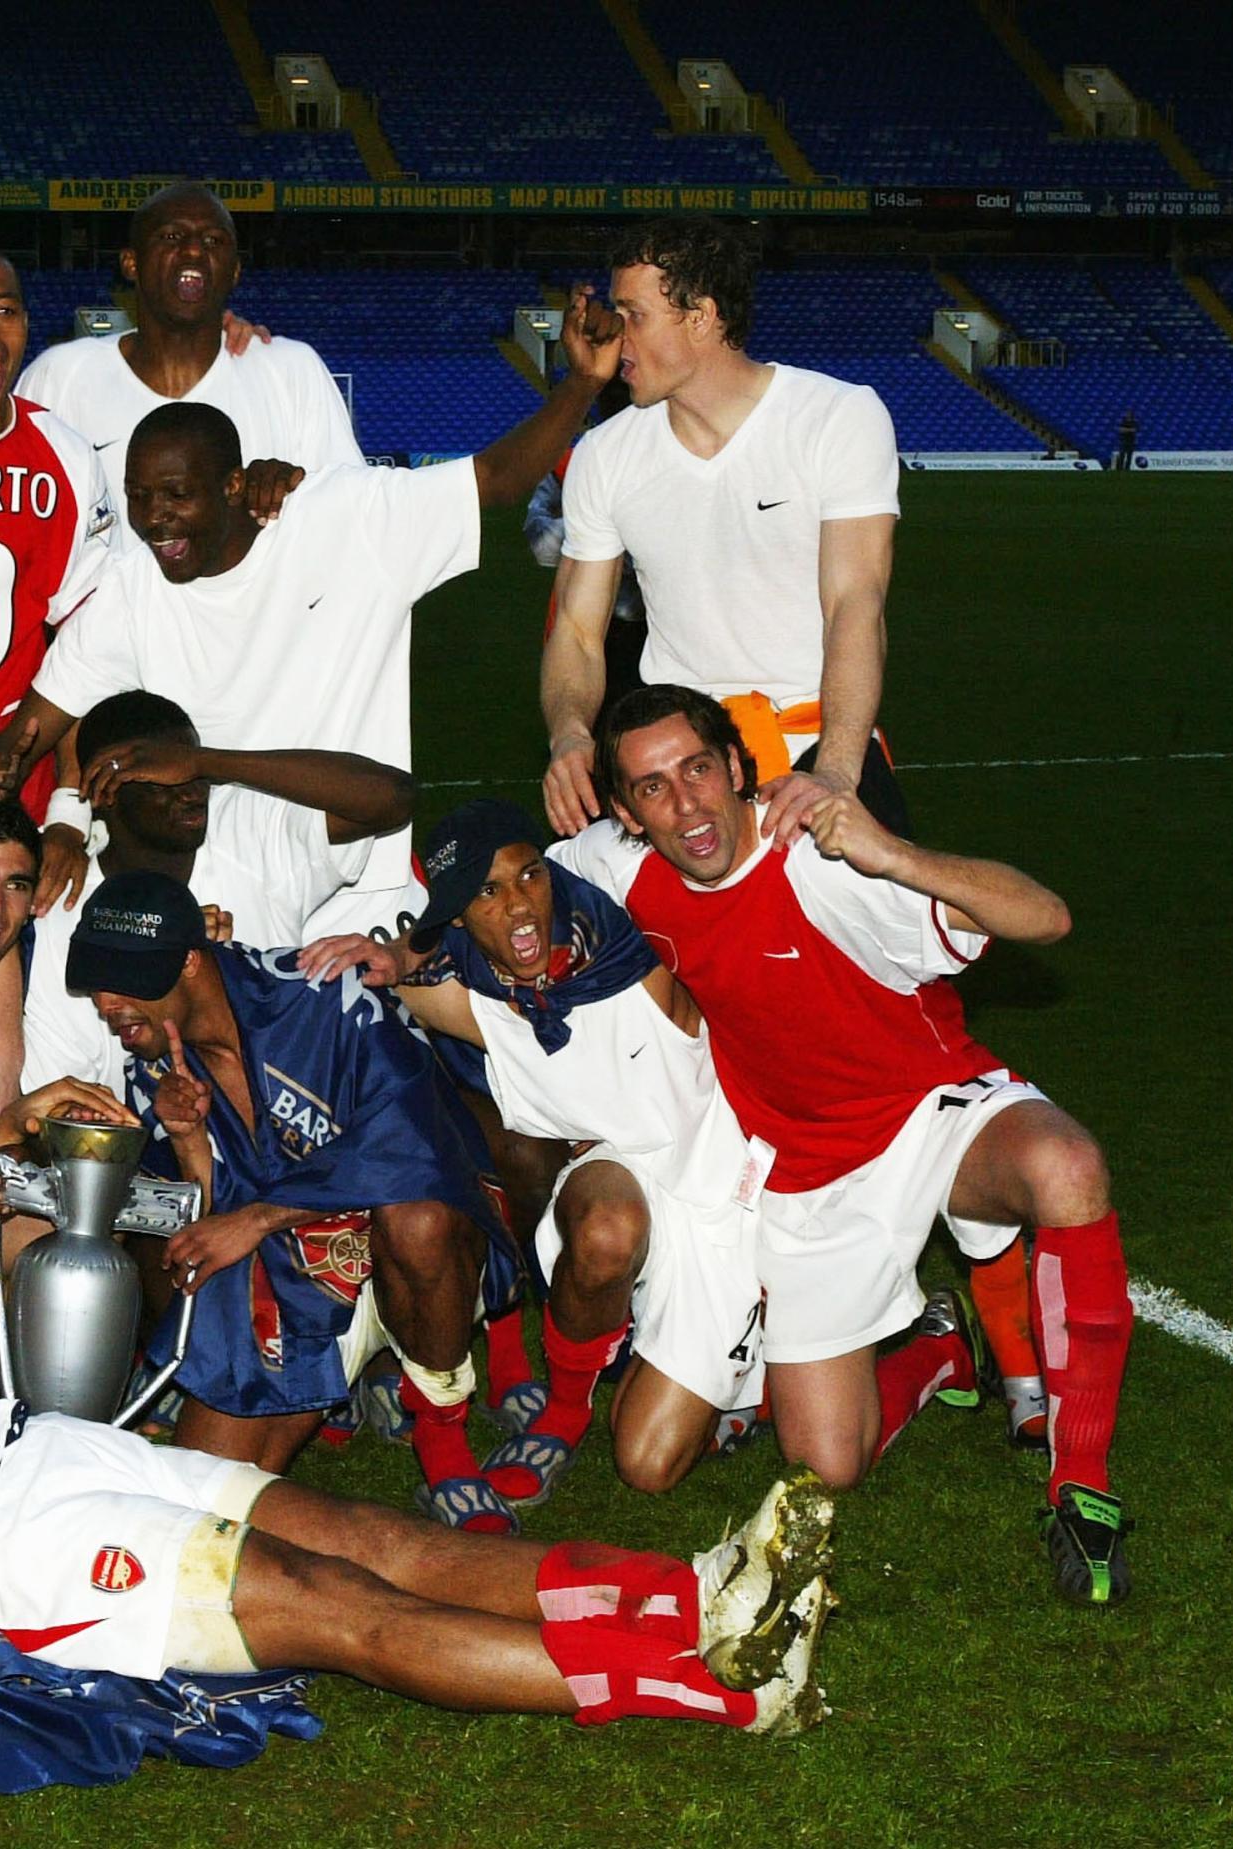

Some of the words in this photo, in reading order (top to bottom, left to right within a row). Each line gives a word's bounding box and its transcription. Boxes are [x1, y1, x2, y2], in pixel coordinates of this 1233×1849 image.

[283, 186, 374, 207] ANDERSON
[380, 187, 492, 208] STRUCTURES
[509, 187, 546, 208] MAP
[554, 188, 605, 208] PLANT
[622, 188, 673, 210] ESSEX
[680, 189, 735, 210] WASTE
[751, 189, 804, 210] RIPLEY
[811, 190, 867, 211] HOMES
[976, 194, 1010, 210] Gold
